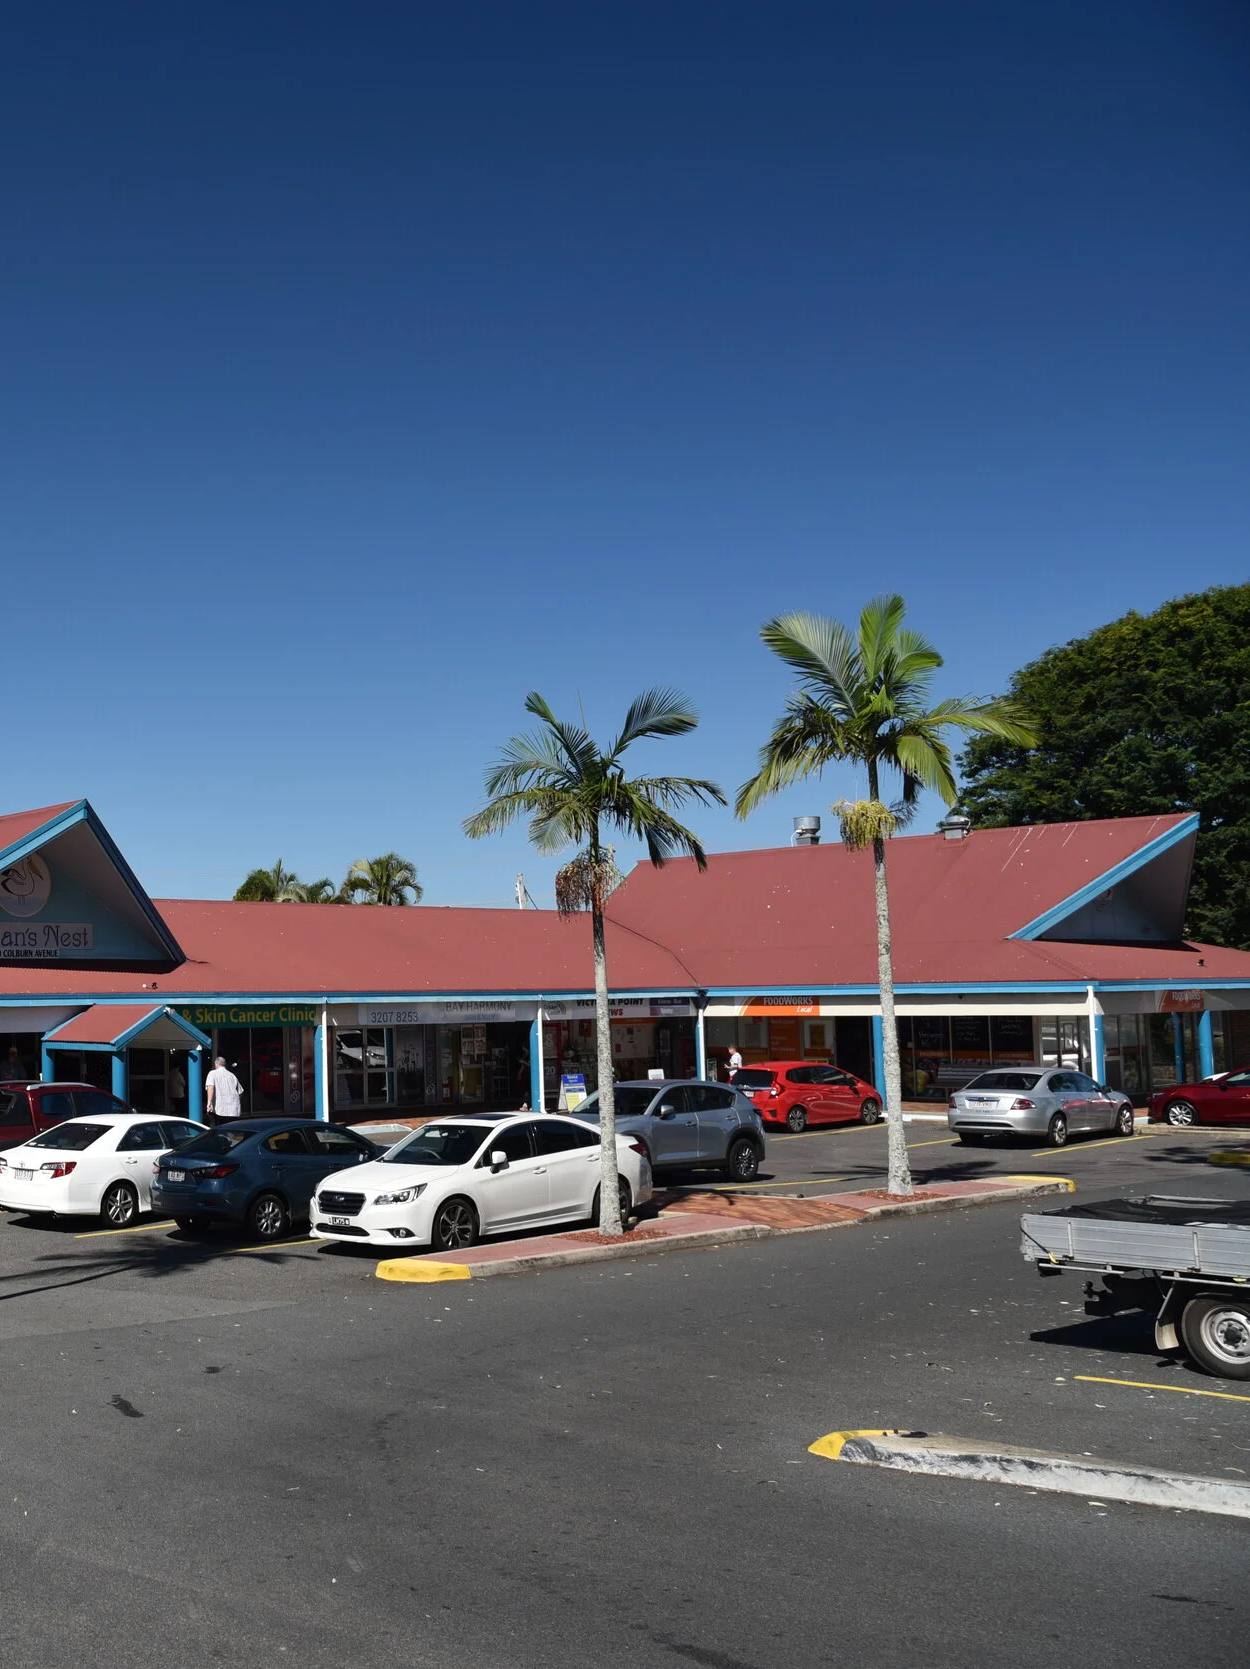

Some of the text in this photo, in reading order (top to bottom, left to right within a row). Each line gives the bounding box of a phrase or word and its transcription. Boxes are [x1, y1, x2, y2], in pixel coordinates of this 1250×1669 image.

[42, 924, 88, 947] Nest
[3, 950, 34, 958] COLBURN
[35, 950, 59, 958] AVENUE
[466, 1001, 512, 1011] HARMONY
[576, 998, 644, 1007] VICTA POINT
[763, 996, 814, 1006] FOODWORKS
[196, 1007, 226, 1024] Skin
[229, 1008, 276, 1023] Cancer
[278, 1007, 315, 1022] Clinic
[371, 1011, 419, 1024] 3207 8253
